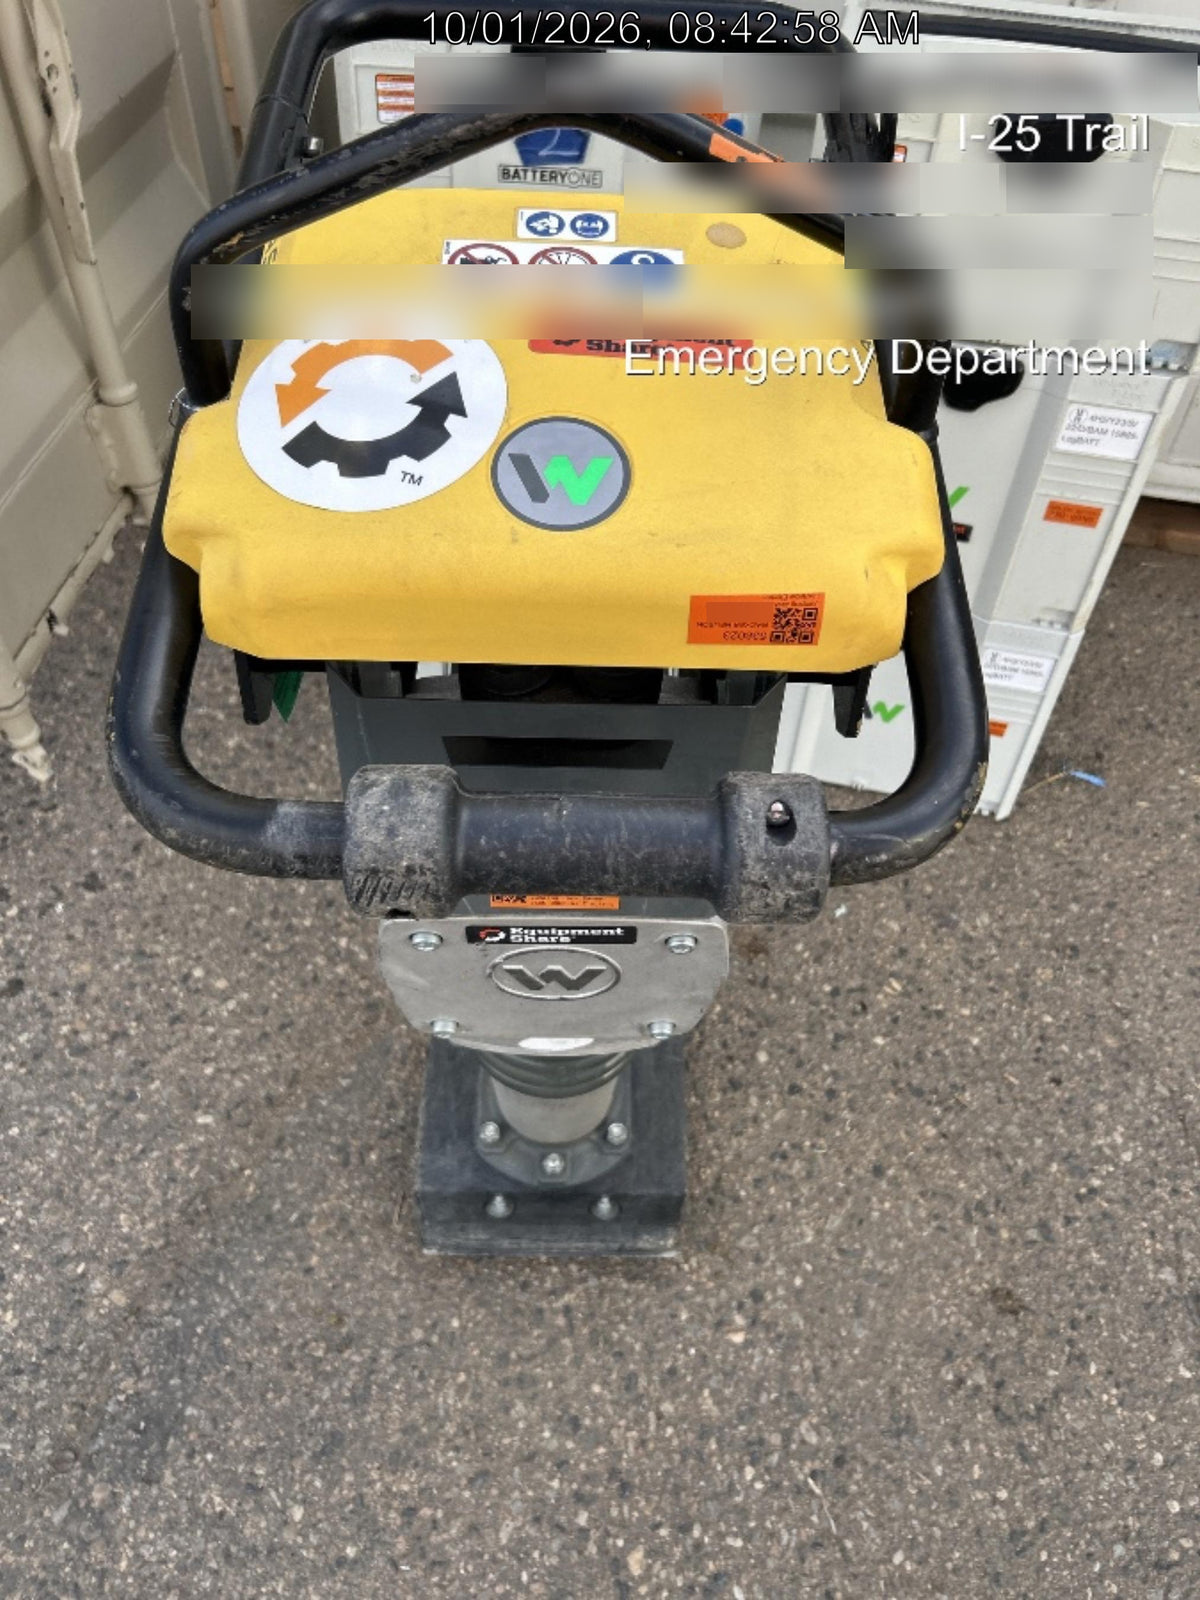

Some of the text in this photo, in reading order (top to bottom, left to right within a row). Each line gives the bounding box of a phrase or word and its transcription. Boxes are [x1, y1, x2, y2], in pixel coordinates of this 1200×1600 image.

[501, 166, 601, 188] BATTERYONE
[400, 470, 423, 487] TM
[509, 927, 625, 937] Equipment
